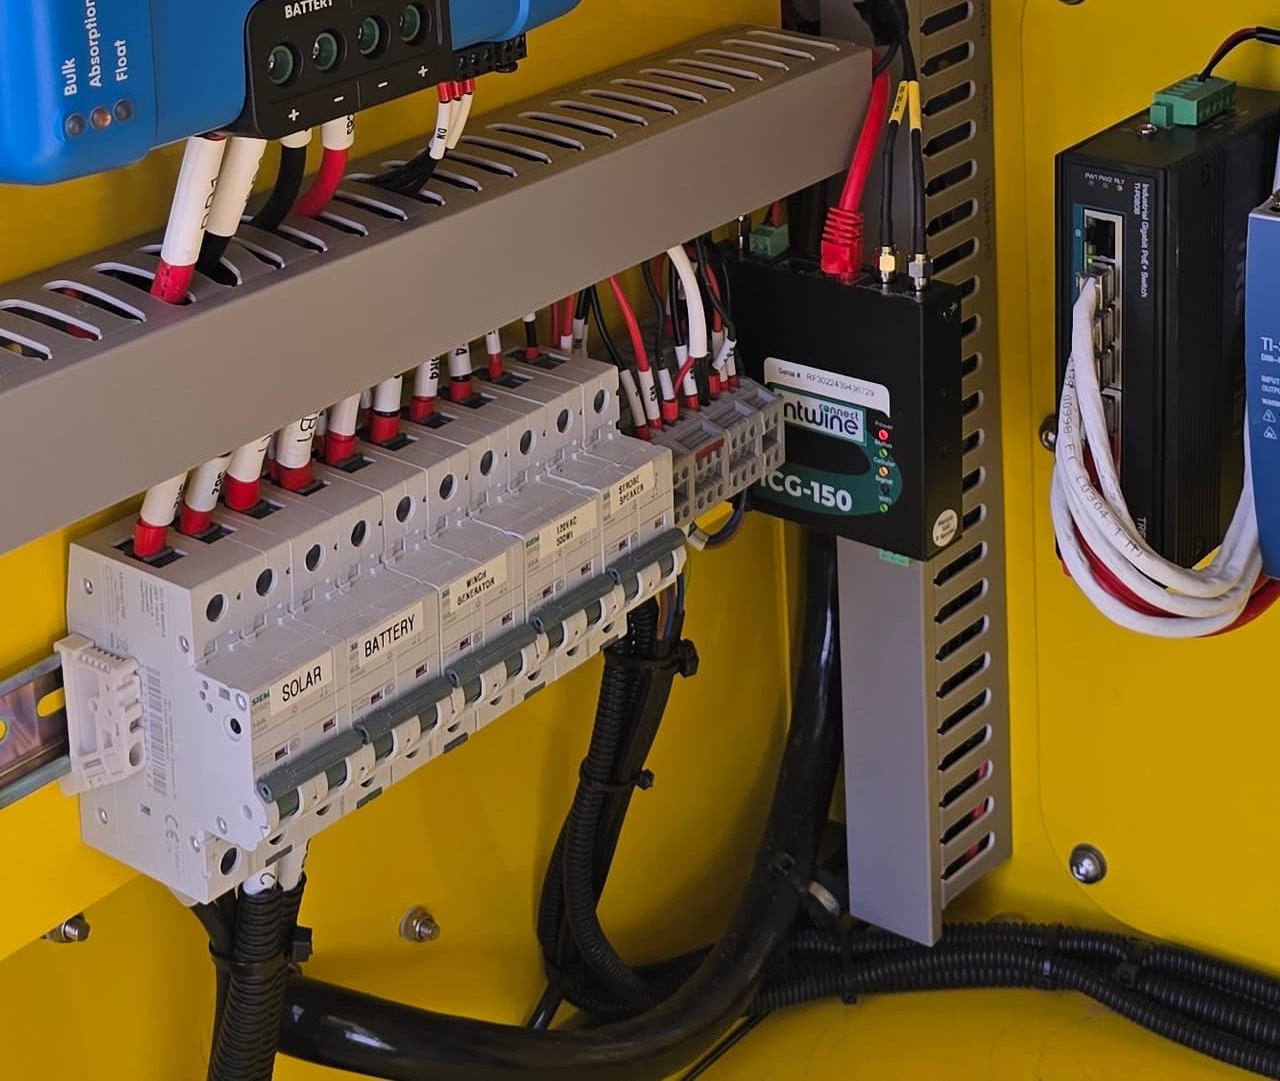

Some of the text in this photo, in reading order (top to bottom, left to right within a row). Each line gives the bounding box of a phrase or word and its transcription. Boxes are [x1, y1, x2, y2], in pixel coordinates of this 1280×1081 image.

[62, 57, 77, 96] Bulk
[114, 39, 128, 81] Float
[784, 400, 858, 435] ntwine
[618, 474, 640, 494] STROBE
[620, 482, 644, 506] SPEAKER
[456, 577, 495, 606] GENERATOR
[466, 570, 487, 588] WINCH
[364, 614, 415, 658] BATTERY
[282, 666, 322, 702] SOLAR
